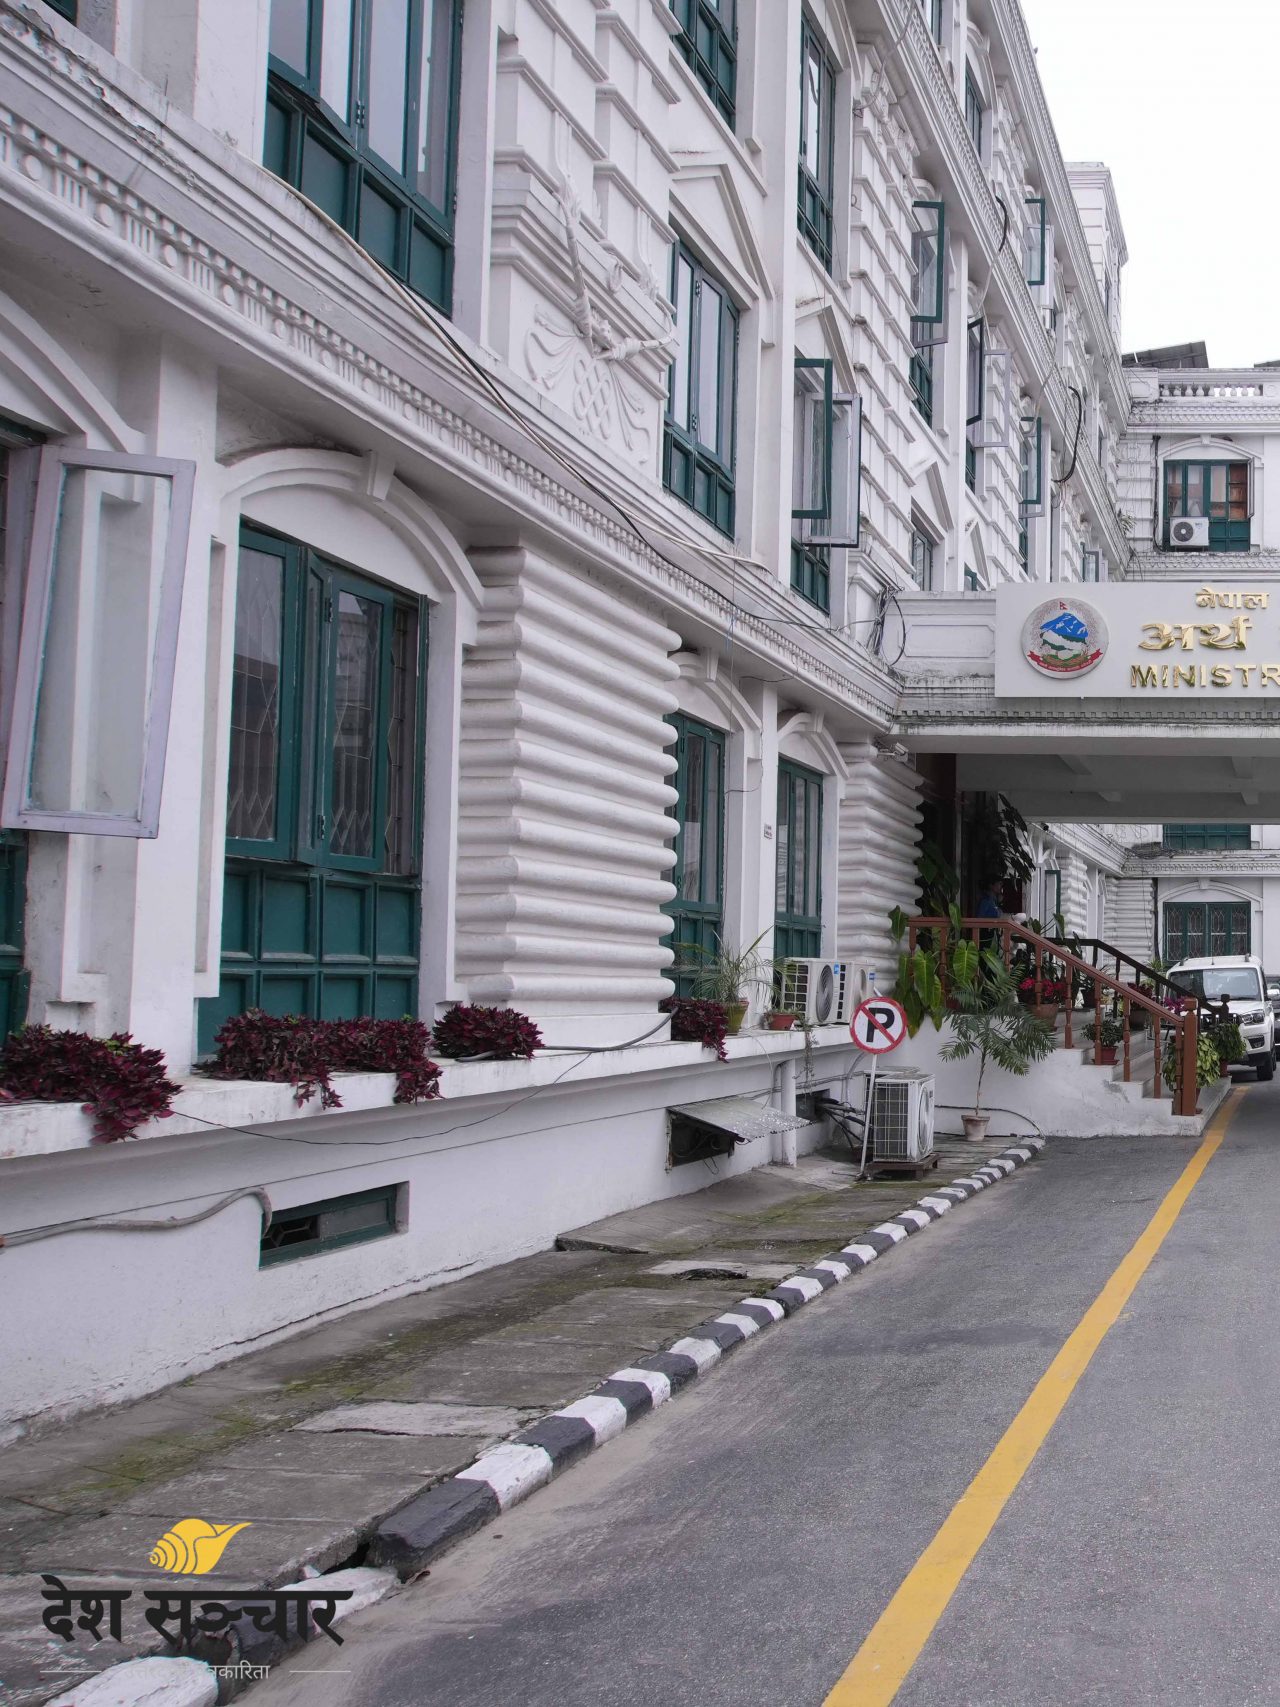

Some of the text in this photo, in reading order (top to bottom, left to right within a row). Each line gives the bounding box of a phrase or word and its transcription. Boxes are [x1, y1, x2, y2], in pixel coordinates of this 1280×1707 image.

[1195, 587, 1269, 609] नेपाल
[1138, 615, 1252, 651] अर्थ
[866, 1007, 895, 1043] P
